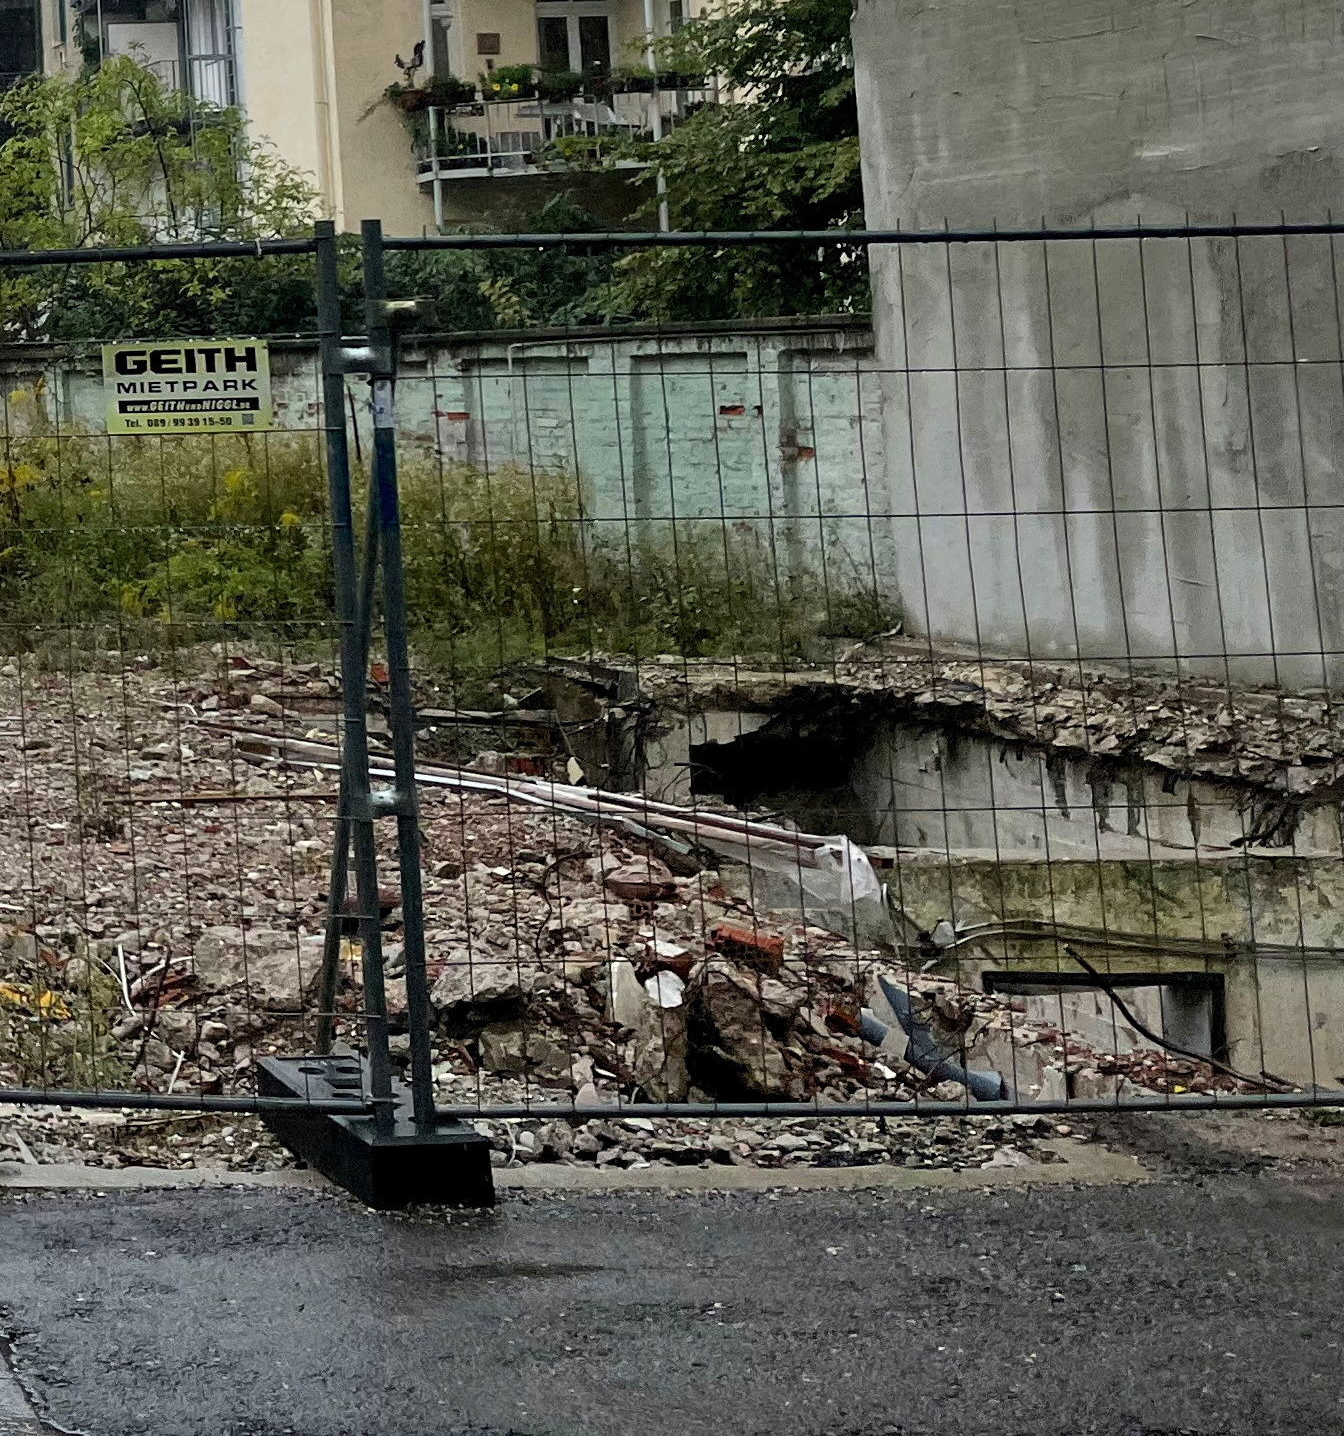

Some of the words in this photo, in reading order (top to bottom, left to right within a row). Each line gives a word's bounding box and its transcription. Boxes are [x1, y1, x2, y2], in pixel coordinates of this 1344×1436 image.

[115, 347, 257, 376] GEITH
[116, 379, 258, 395] MIETPARK
[125, 419, 142, 428] Tel.
[147, 418, 166, 428] 089
